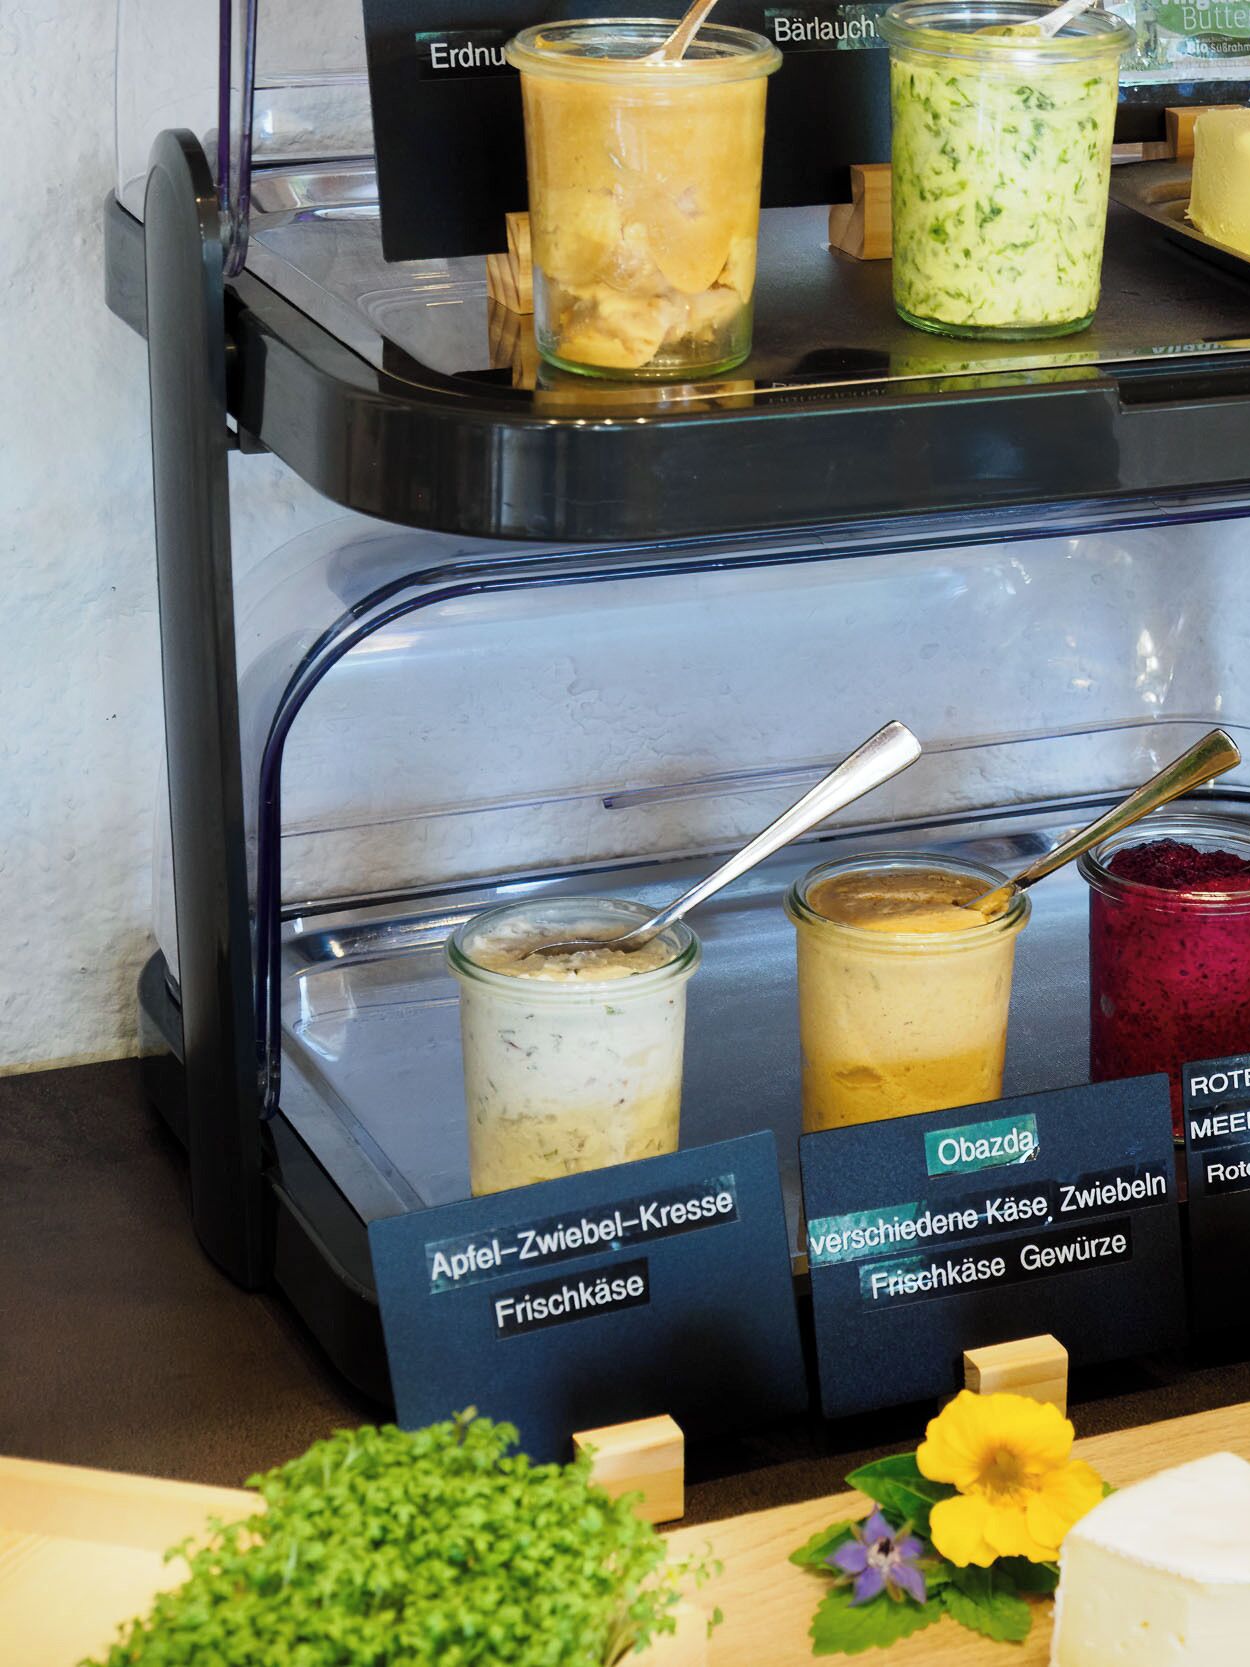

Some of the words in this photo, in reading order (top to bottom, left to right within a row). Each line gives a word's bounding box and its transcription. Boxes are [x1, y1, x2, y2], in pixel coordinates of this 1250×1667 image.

[774, 14, 880, 42] Bärlauch
[430, 41, 506, 69] Erdnu
[937, 1128, 1034, 1165] Obazda
[809, 1210, 978, 1255] verschiedene
[1060, 1172, 1167, 1212] Zwiebeln
[870, 1254, 1006, 1300] Frischkäse
[1019, 1233, 1128, 1272] Gewürze
[494, 1272, 645, 1329] Frischkäse
